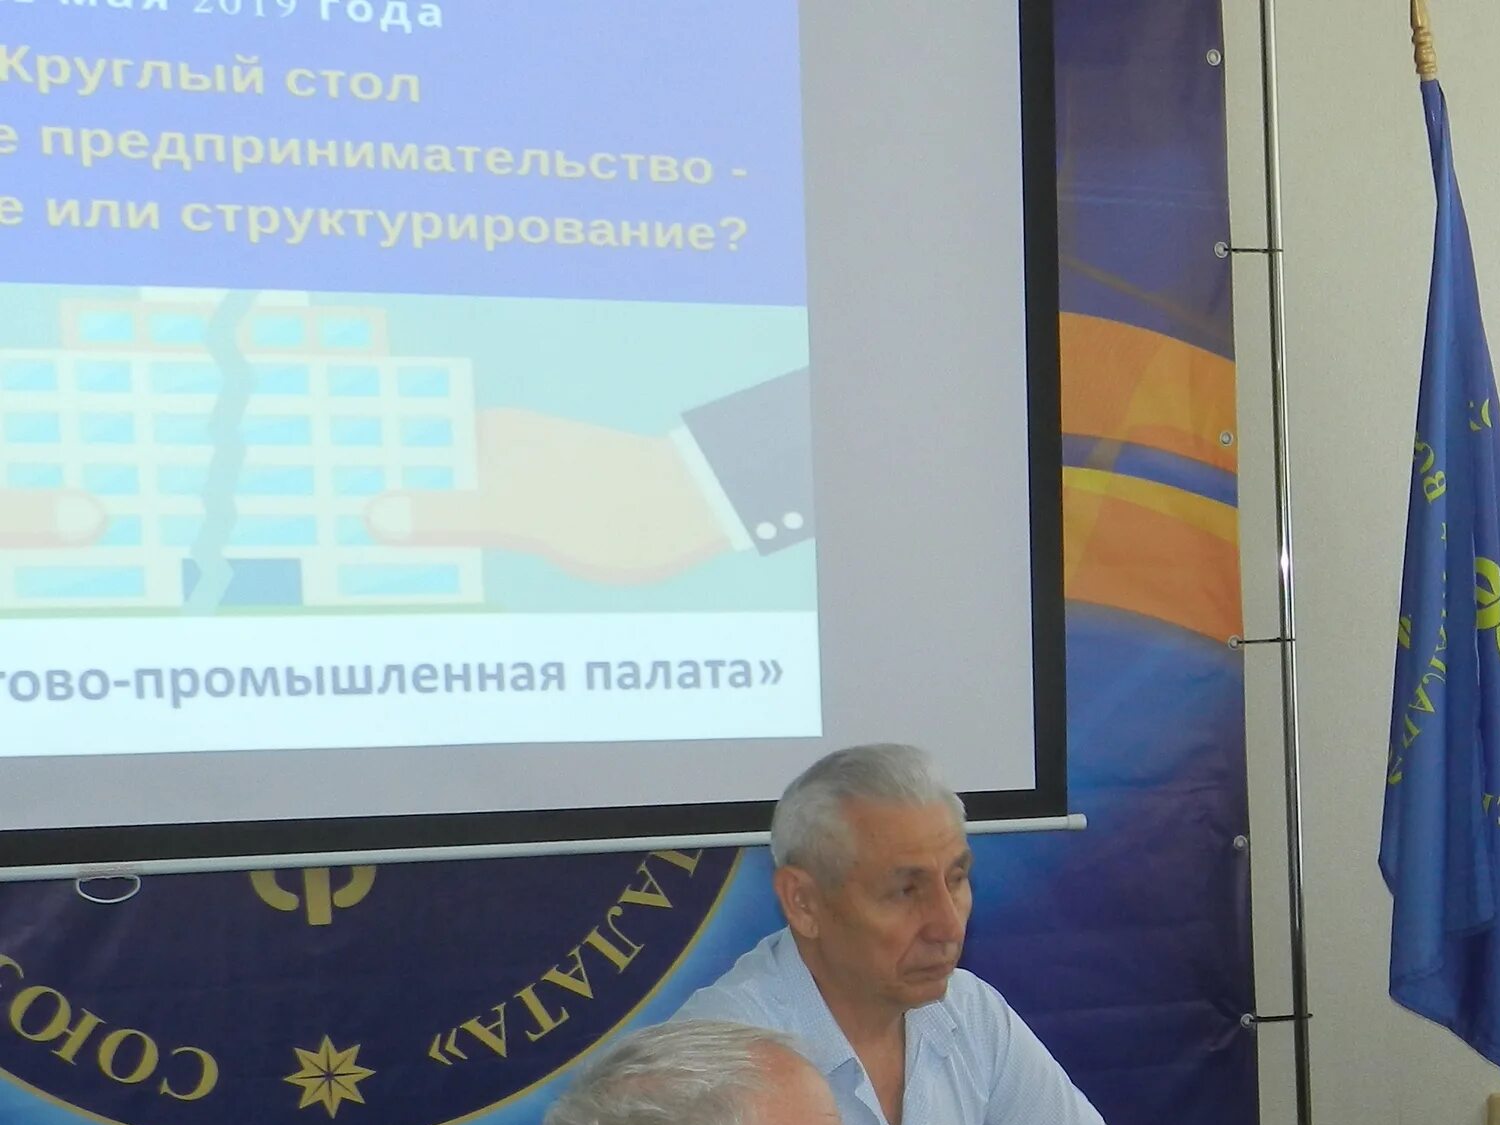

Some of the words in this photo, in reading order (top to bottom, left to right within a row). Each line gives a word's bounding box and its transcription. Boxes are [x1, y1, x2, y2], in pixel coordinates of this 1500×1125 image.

[320, 0, 443, 34] года
[0, 44, 265, 97] Круглый
[286, 68, 421, 102] стол
[41, 125, 713, 185] предпринимательство
[47, 197, 160, 231] или
[181, 201, 748, 252] структурирование?
[0, 660, 566, 709] ово-промышленная
[585, 657, 784, 691] палата»
